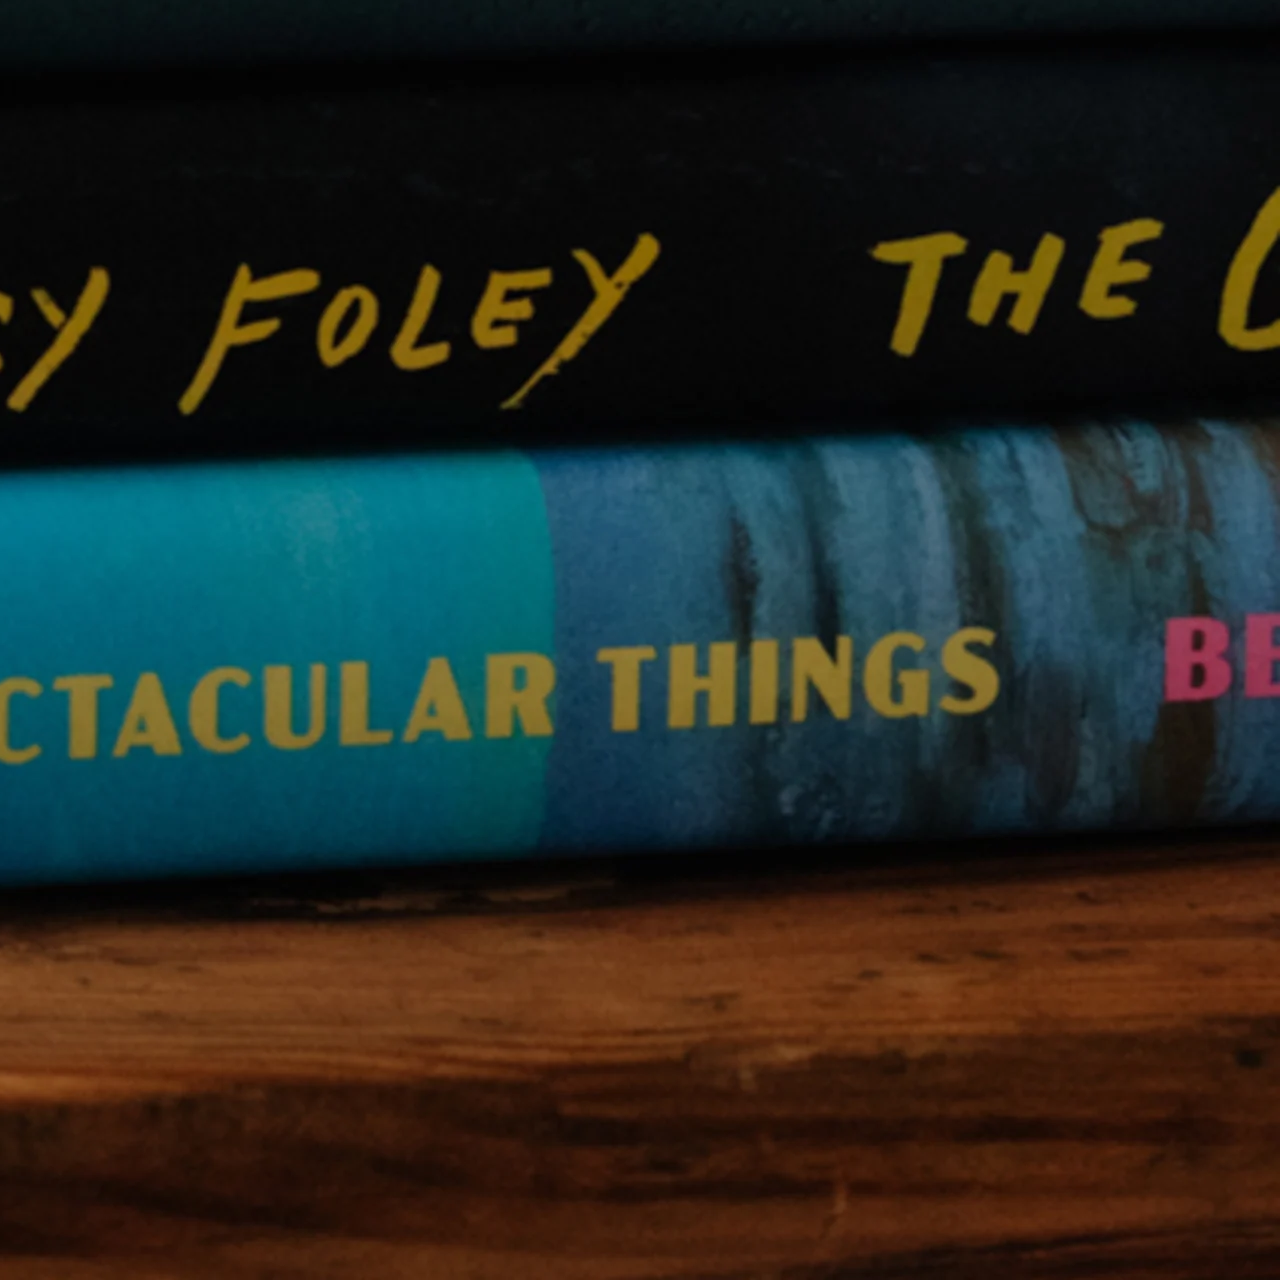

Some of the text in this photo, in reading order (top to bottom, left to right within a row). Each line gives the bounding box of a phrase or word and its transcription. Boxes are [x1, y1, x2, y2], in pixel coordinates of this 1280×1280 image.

[179, 232, 660, 413] FOLEY
[869, 217, 1164, 357] THE
[596, 626, 1000, 732] THINGS
